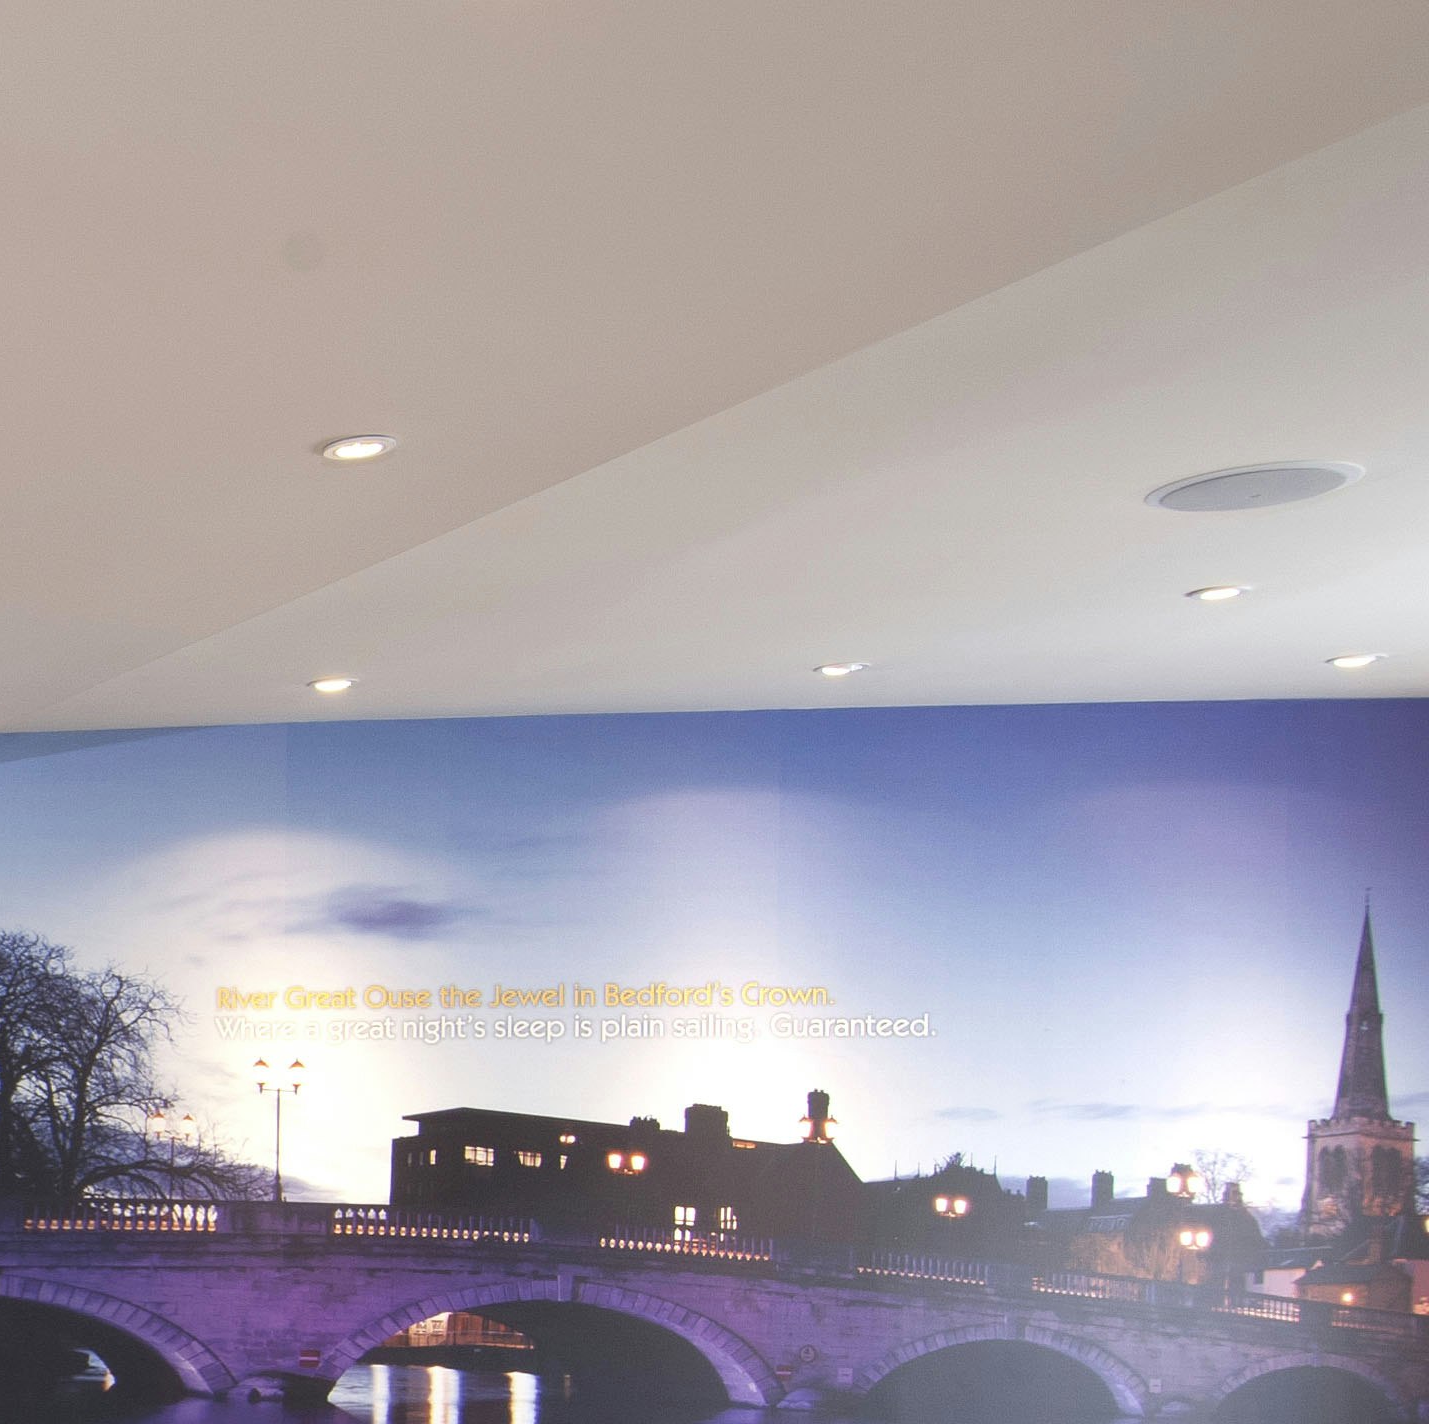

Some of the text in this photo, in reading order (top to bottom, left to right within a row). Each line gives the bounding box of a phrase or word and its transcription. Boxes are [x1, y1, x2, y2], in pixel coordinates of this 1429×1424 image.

[217, 981, 836, 1009] River Great Ouse the Jewel in Bedford's Crown.
[215, 1016, 297, 1040] Where
[305, 1023, 320, 1040] a
[329, 1017, 395, 1044] great
[403, 1015, 486, 1044] night's
[494, 1015, 565, 1042] sleep
[575, 1015, 593, 1038] is
[601, 1014, 664, 1042] plain
[770, 1012, 937, 1038] Guaranteed.
